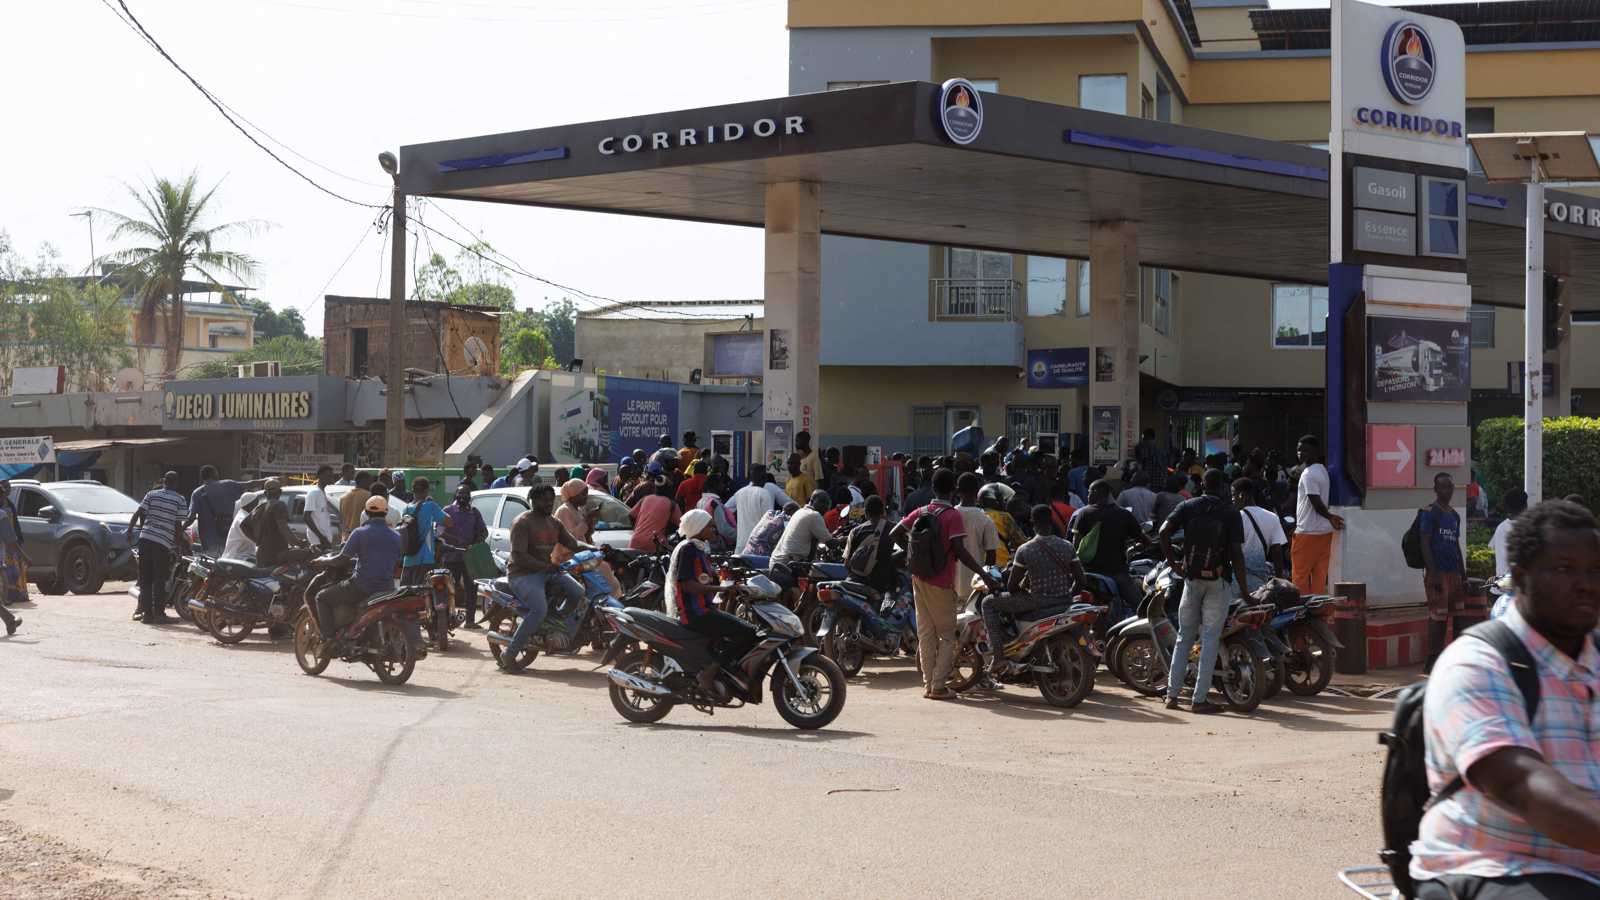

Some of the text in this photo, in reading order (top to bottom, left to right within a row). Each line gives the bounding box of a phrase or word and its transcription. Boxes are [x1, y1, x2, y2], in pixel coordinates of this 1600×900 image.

[1356, 106, 1463, 138] CORRIDOR
[598, 115, 807, 156] CORRIDOR
[1367, 182, 1407, 200] Gasoil
[1364, 221, 1409, 237] Essence
[176, 391, 311, 419] DECO LUMINAIRES
[626, 400, 661, 413] LE PARFAIT
[621, 413, 668, 426] PRODUIT POUR
[619, 426, 641, 438] VOTRE
